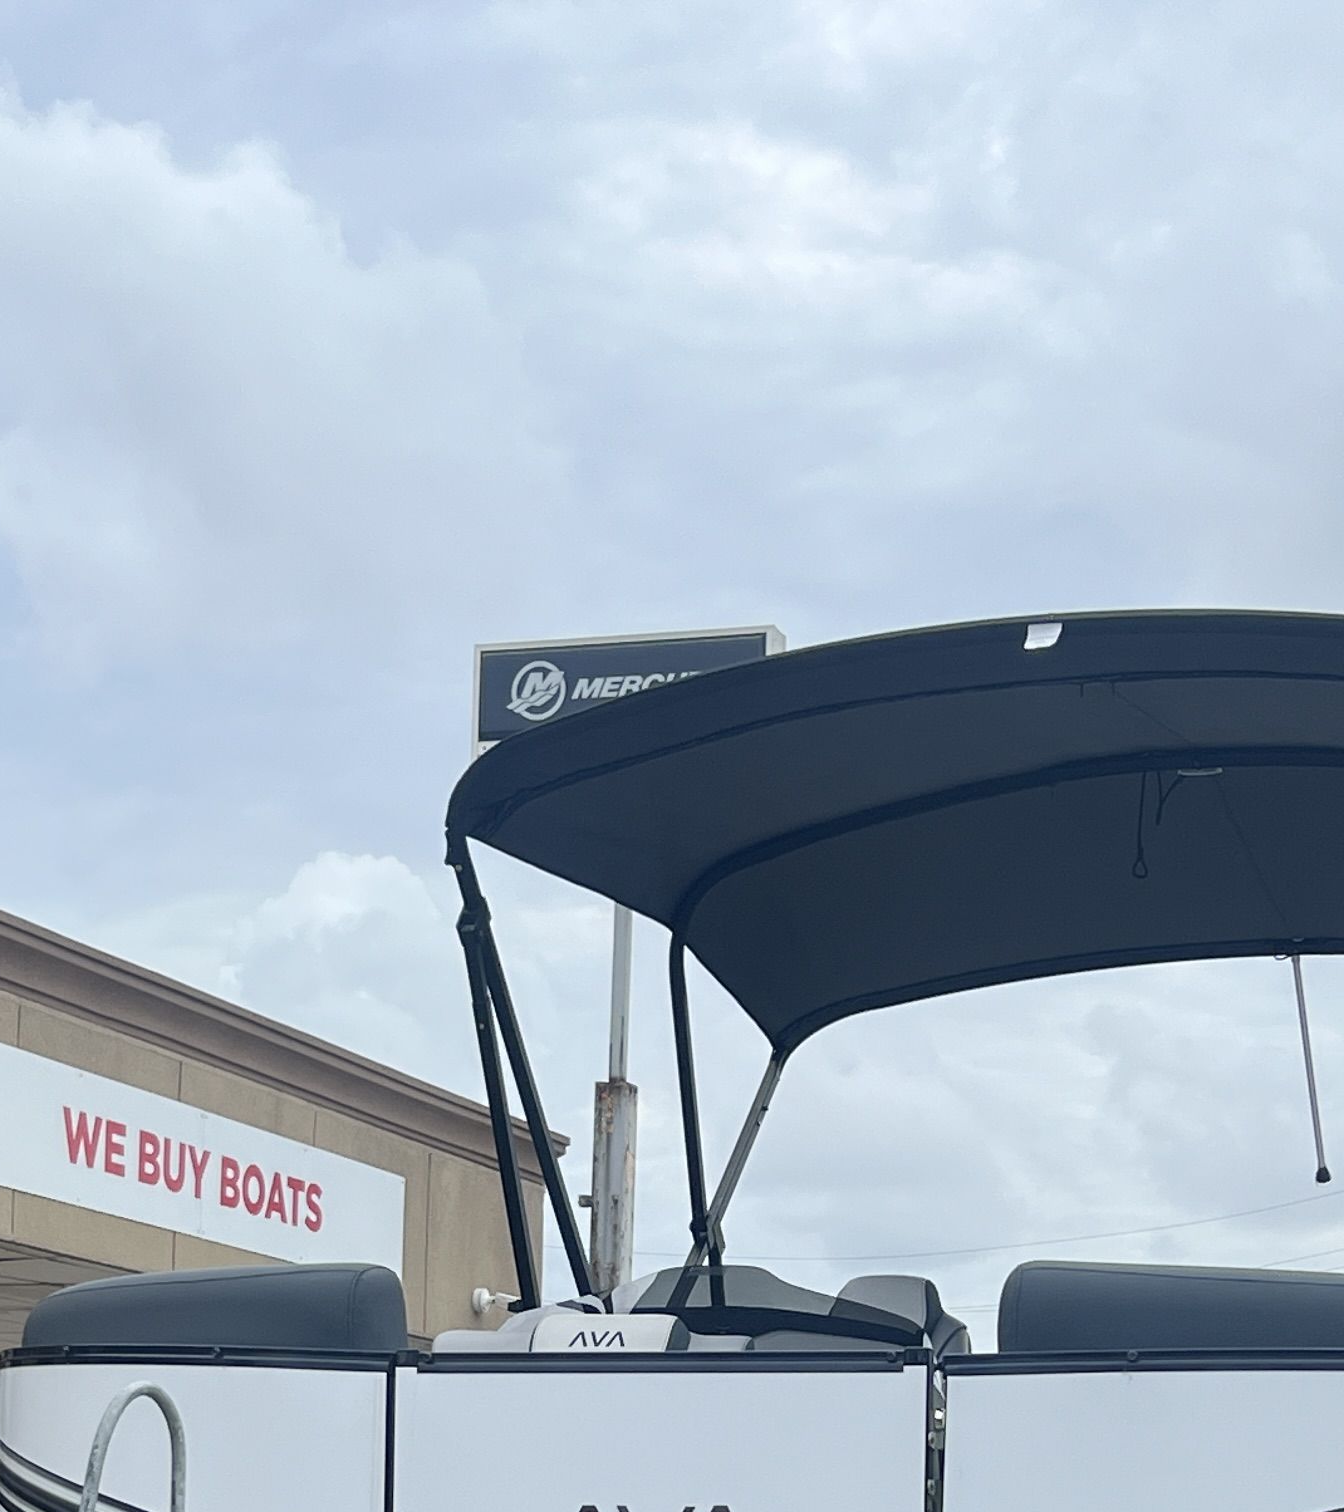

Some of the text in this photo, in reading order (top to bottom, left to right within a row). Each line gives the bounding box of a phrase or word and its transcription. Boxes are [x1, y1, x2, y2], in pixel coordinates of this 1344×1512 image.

[63, 1106, 323, 1232] WE BUY BOATS
[568, 1330, 625, 1347] AVA
